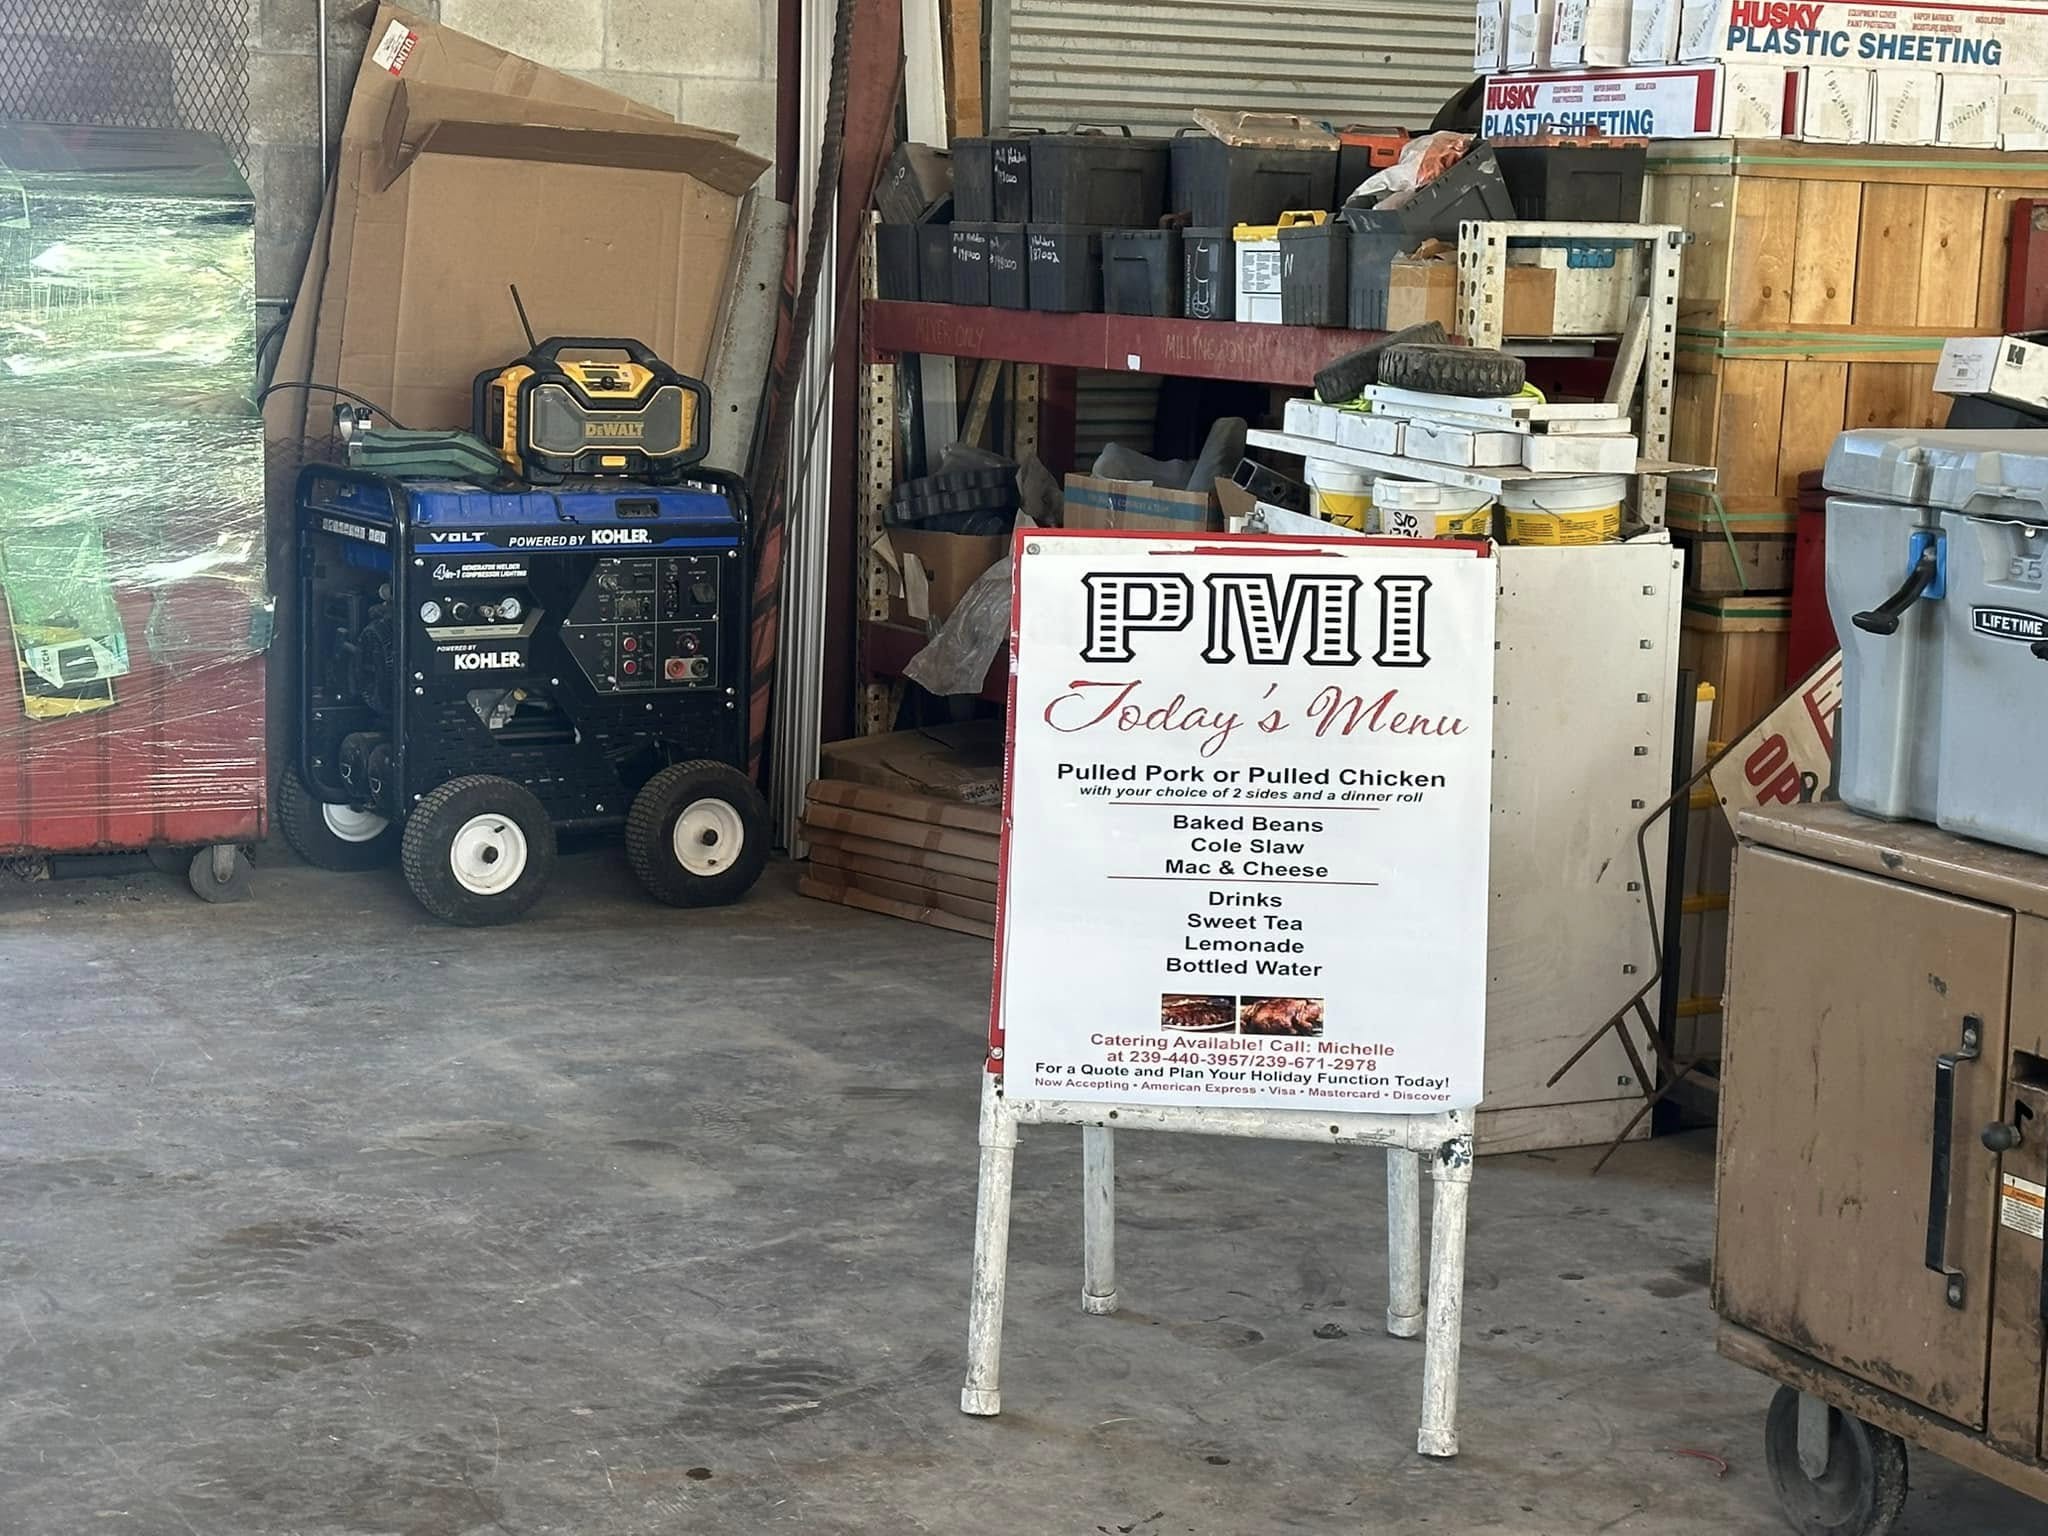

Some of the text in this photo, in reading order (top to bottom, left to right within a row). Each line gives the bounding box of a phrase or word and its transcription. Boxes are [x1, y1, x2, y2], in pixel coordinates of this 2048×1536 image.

[1731, 0, 1824, 30] HUSKY
[392, 37, 416, 71] ULINE
[1727, 26, 2002, 66] PLASTIC SHEETING
[1486, 84, 1540, 110] HUSKY
[430, 531, 486, 543] VOLT
[509, 528, 650, 547] POWERED BY KOHLER
[2009, 558, 2042, 580] 55
[1079, 571, 1434, 669] PMI
[1982, 612, 2043, 636] LIFETIME
[436, 644, 477, 653] POWERED BY
[455, 651, 520, 670] KOHLER
[1044, 680, 1470, 759] Today's Menu
[1057, 762, 1446, 788] Pulled Pork or Pulled Chicken
[1080, 785, 1424, 803] with your choice of 2 sides and a dinner roll
[1173, 814, 1324, 833] Baked Beans
[1190, 836, 1305, 855] Cole Slaw
[1165, 858, 1329, 878] Mac & Cheese
[1208, 890, 1283, 908] Drinks
[1187, 912, 1303, 932] Sweet Tea
[1184, 935, 1305, 954] Lemonade
[1166, 957, 1324, 977] Bottled Water
[1090, 1033, 1395, 1057] Catering Available! Call: Michelle
[1107, 1050, 1377, 1072] at 239-440-3957/239-671-2978
[1035, 1062, 1450, 1091] For a Quote and Plan Your Holiday Function Today!
[1035, 1077, 1452, 1102] Now Accepting American Express Visa Mastercard Discover
